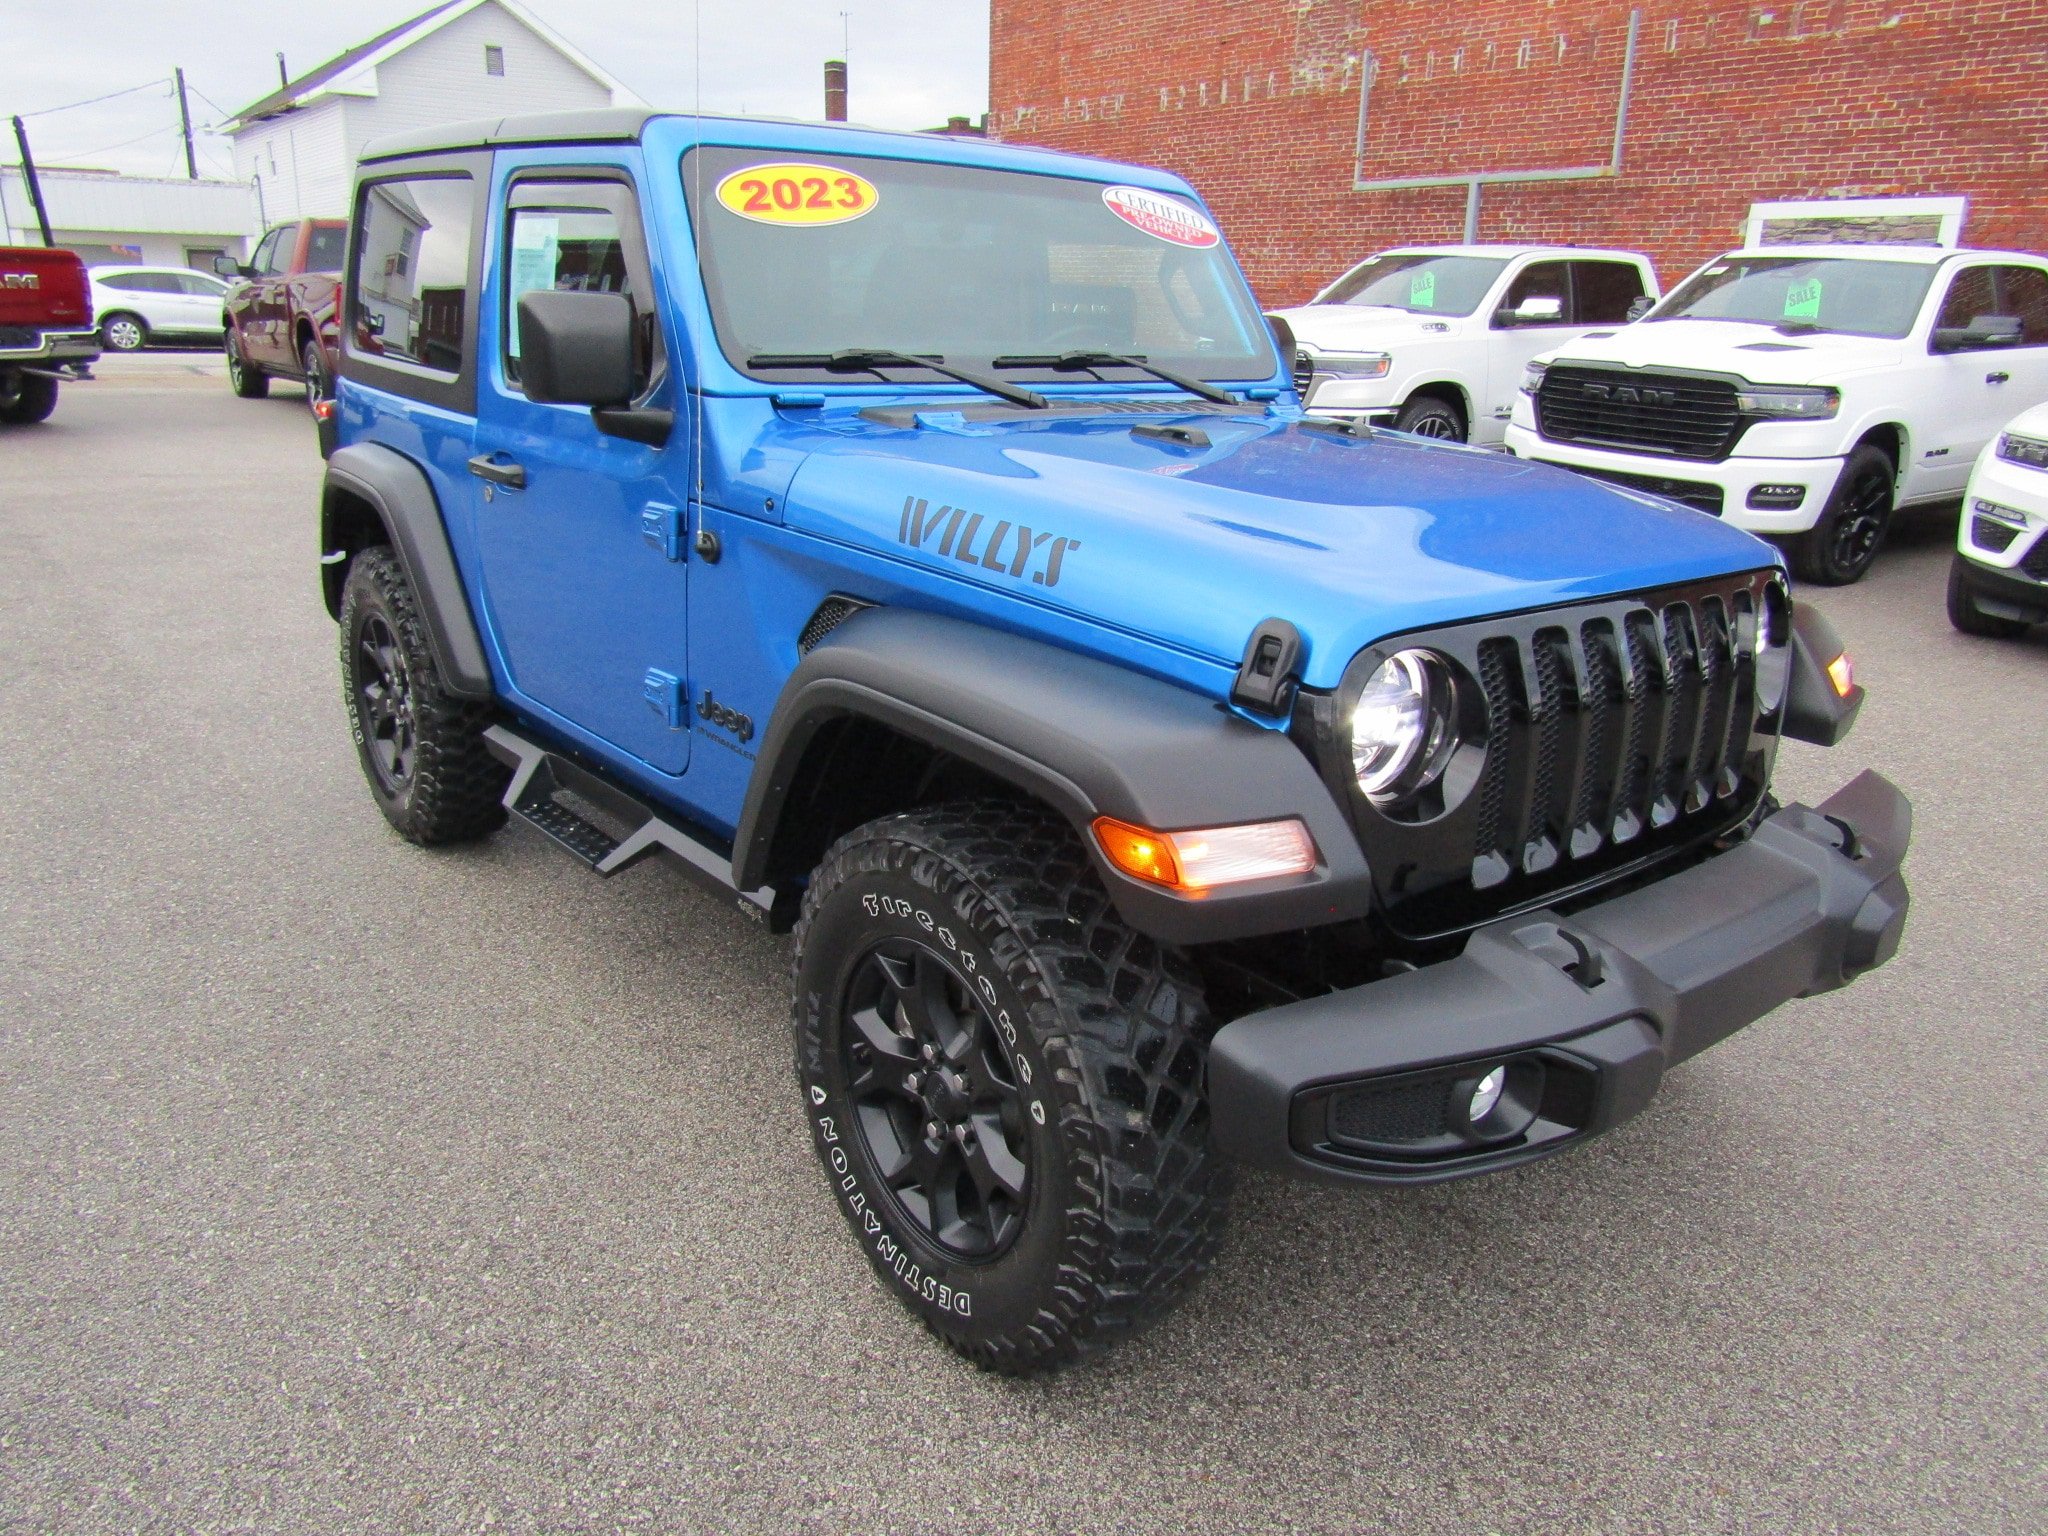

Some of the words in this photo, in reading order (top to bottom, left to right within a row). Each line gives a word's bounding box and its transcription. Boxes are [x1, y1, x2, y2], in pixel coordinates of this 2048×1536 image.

[739, 177, 865, 212] 2023
[1114, 190, 1204, 229] CERTIFIED
[1789, 286, 1818, 307] SALE
[1582, 383, 1676, 406] RAM
[898, 495, 1082, 588] WILLYS
[696, 689, 755, 744] Jeep
[819, 1116, 972, 1317] DESTINATION
